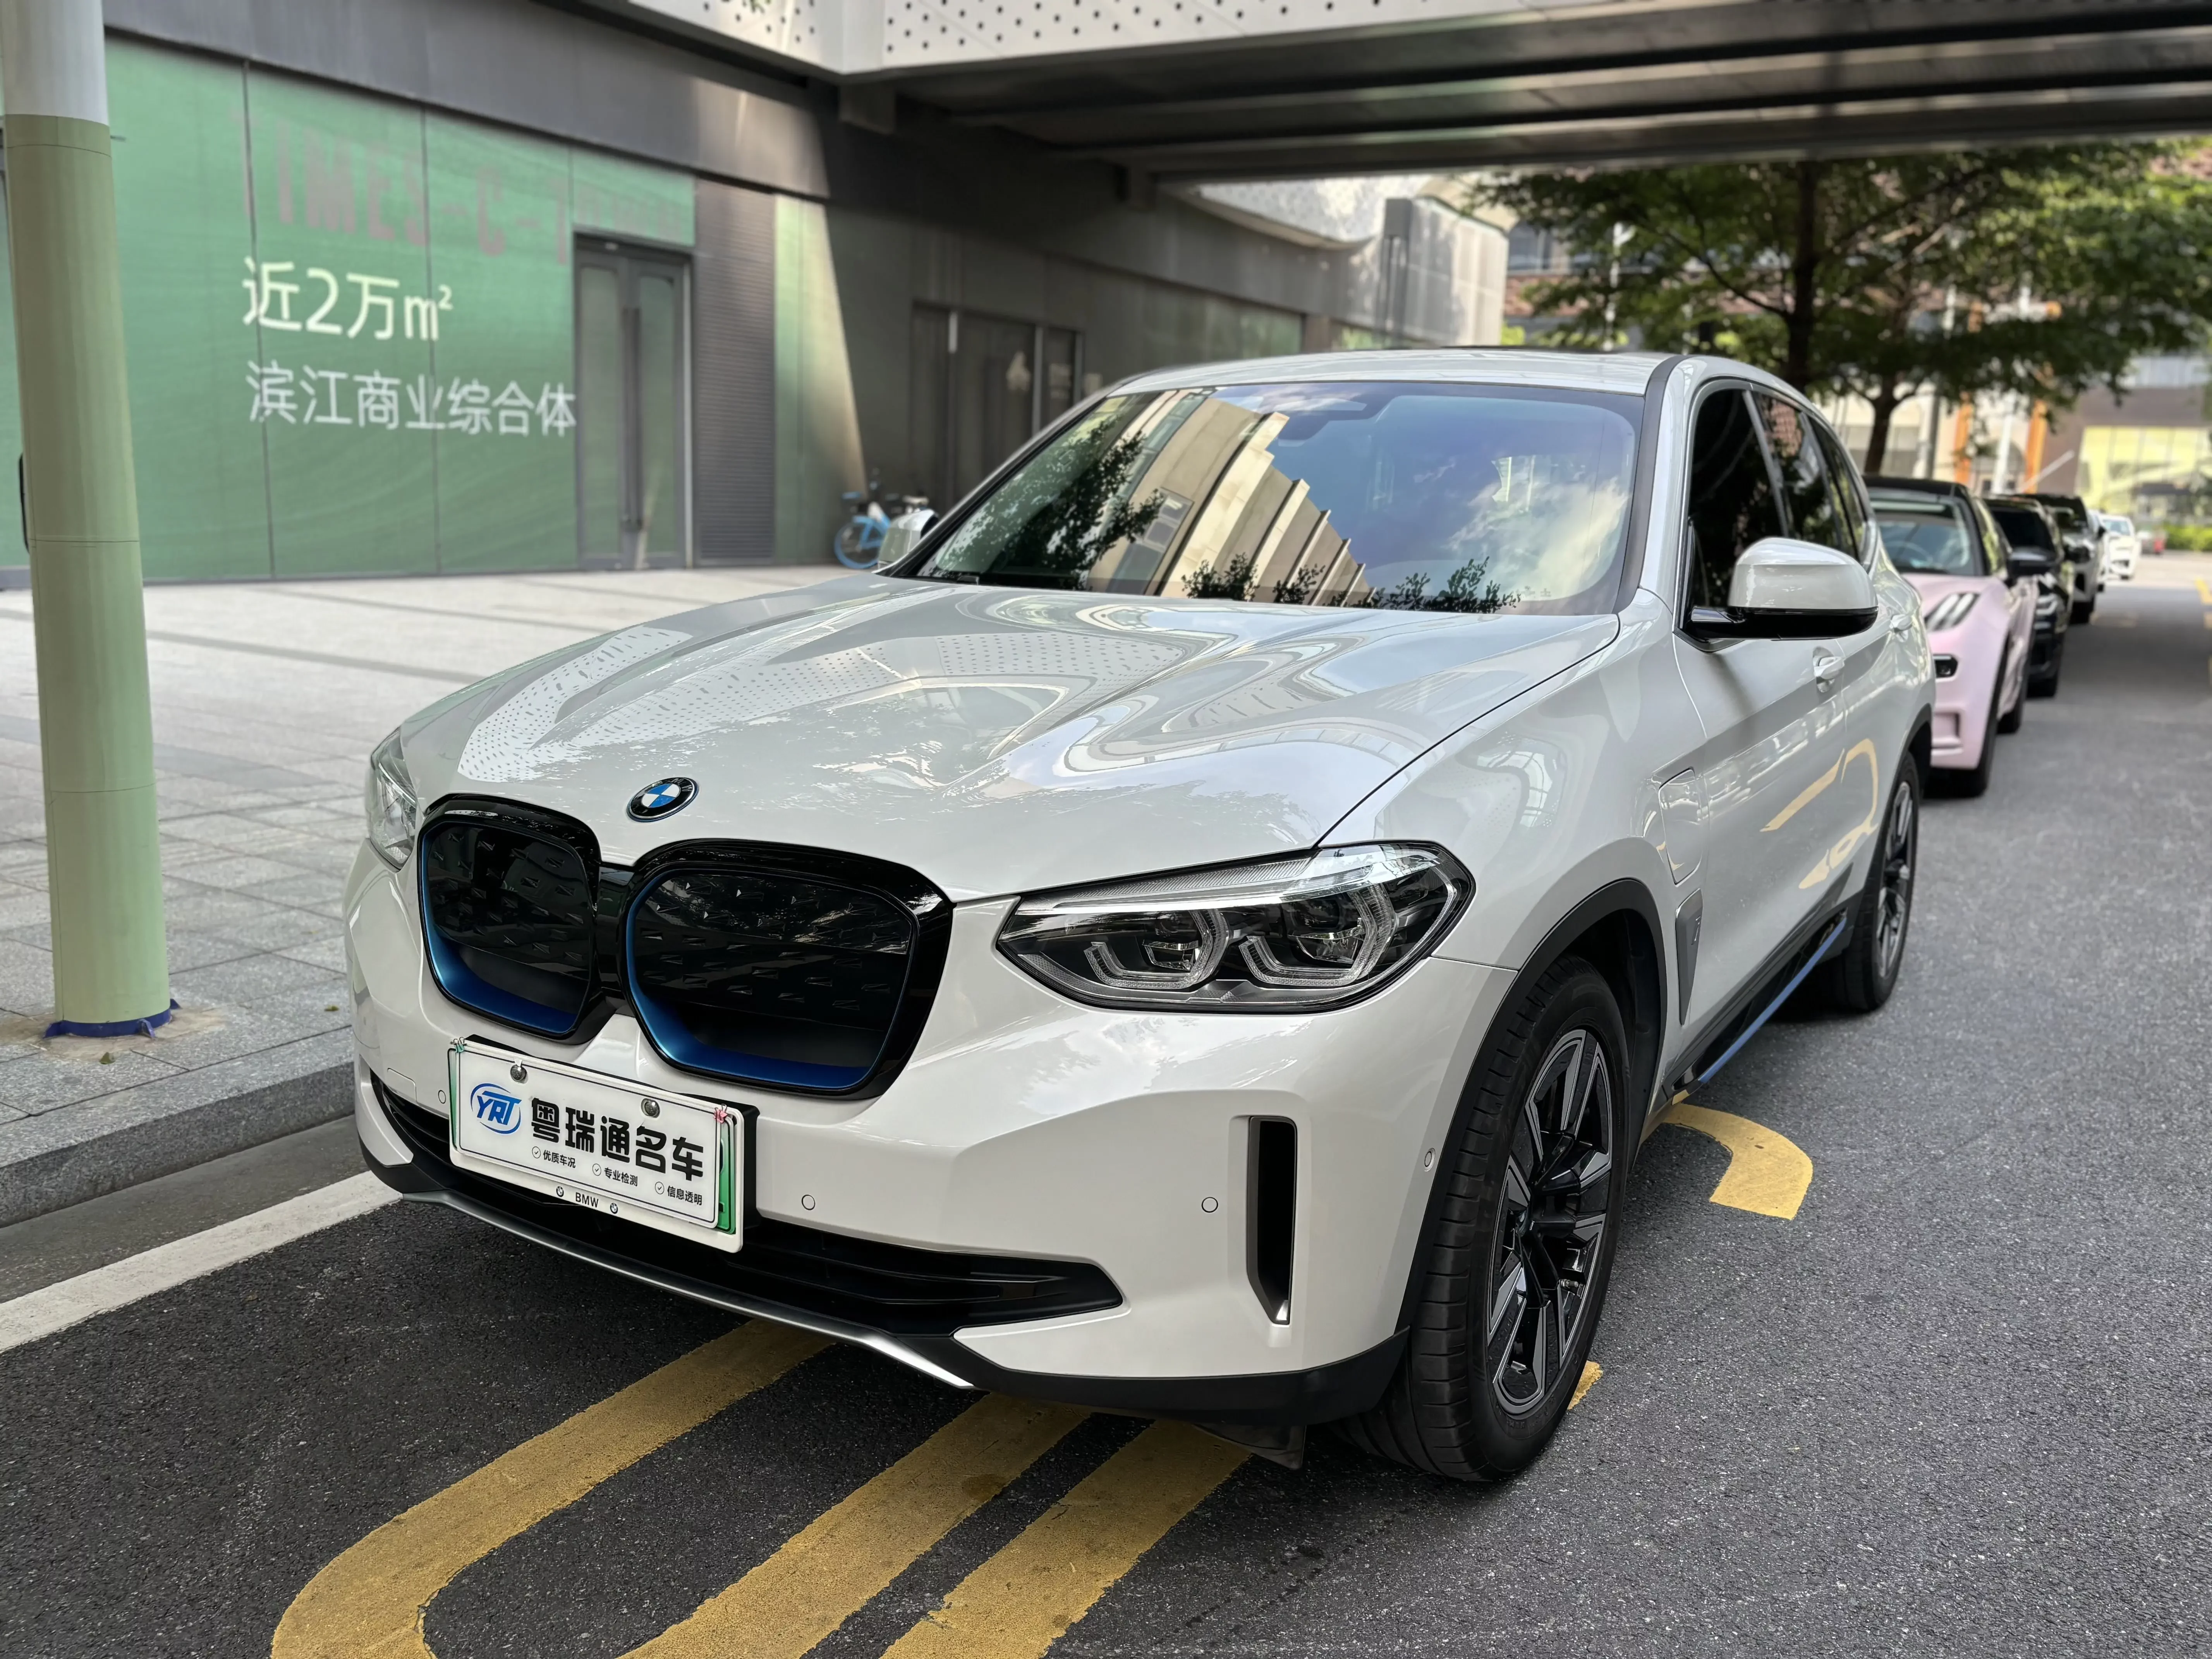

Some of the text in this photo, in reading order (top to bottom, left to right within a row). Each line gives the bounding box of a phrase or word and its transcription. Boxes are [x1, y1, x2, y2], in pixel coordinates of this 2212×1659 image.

[246, 360, 577, 436] 滨江商业综合体
[531, 1097, 704, 1182] 粤瑞通名车
[543, 1149, 703, 1206] 优质车况 专业检测 信息透明
[575, 1192, 599, 1207] BMW
